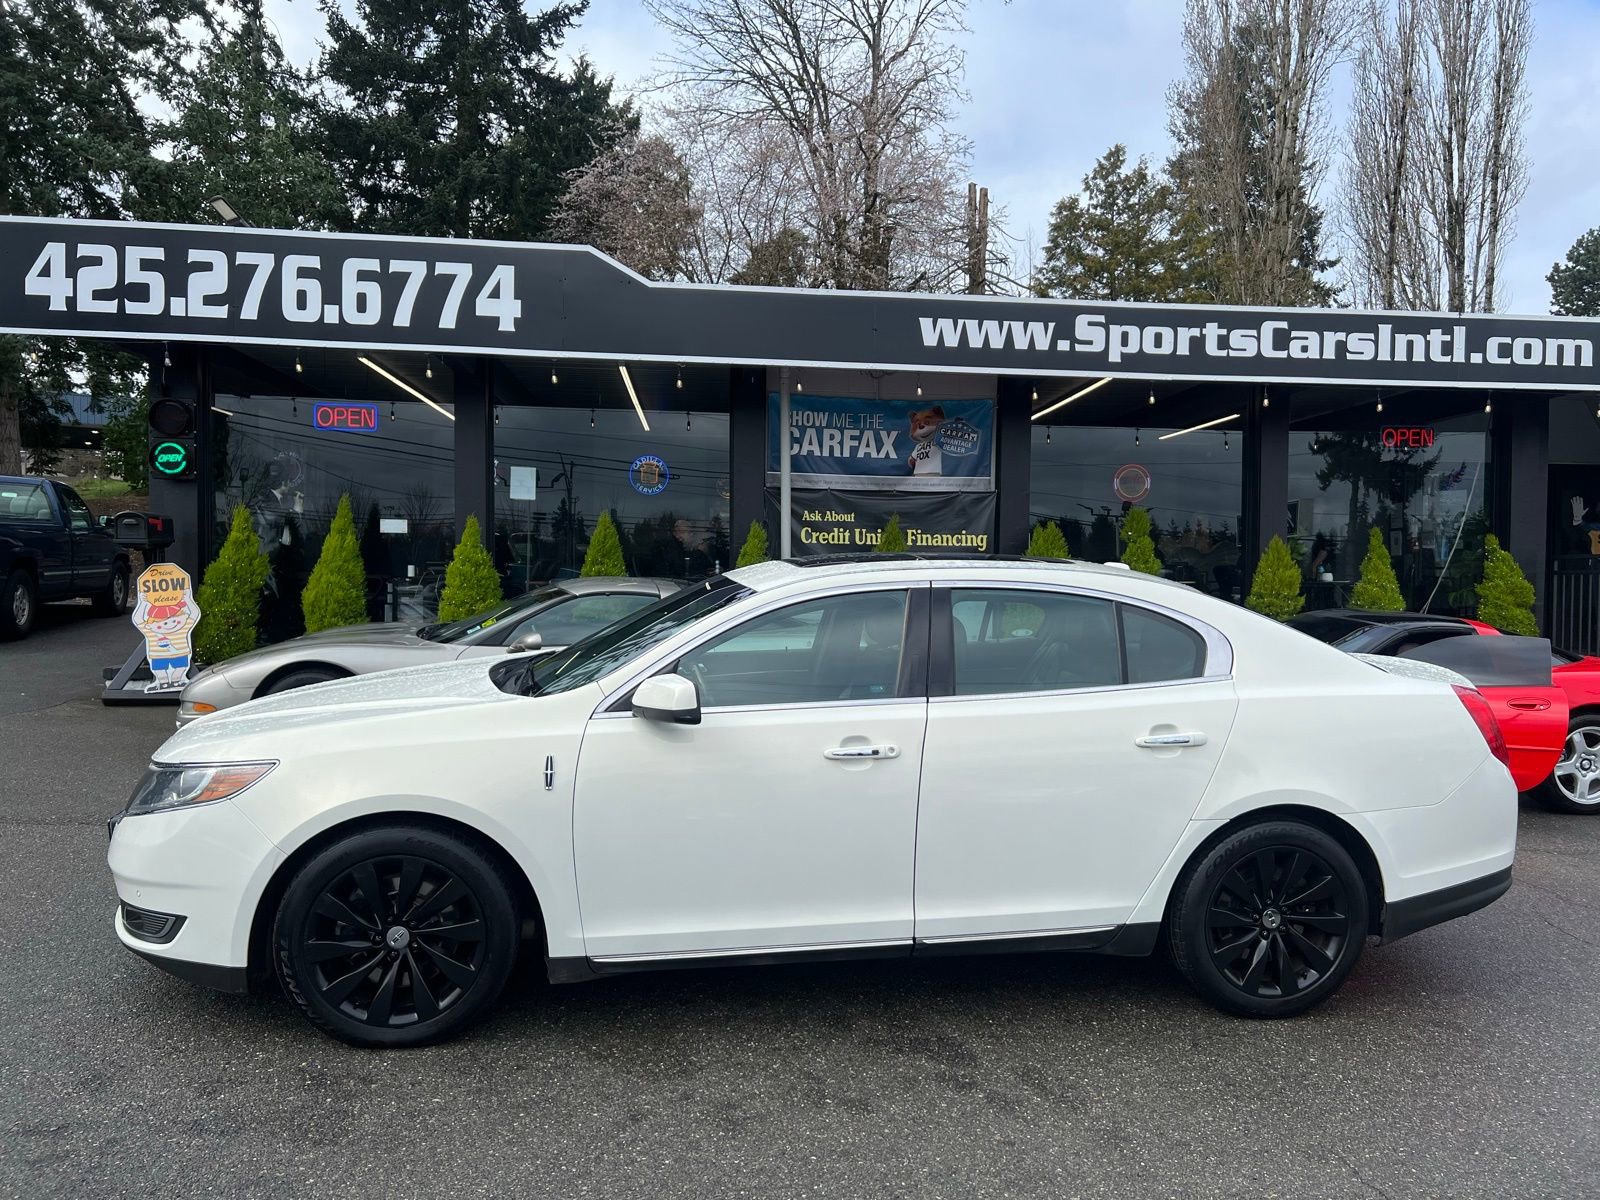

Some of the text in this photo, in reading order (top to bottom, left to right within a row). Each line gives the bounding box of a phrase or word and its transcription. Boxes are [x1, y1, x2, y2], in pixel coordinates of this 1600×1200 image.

[24, 241, 522, 332] 425.276.6774
[919, 313, 1594, 367] www.SportsCarsIntl.com
[316, 406, 376, 428] OPEN
[789, 410, 884, 429] HOW ME THE
[940, 427, 977, 442] CARFAX
[1381, 427, 1434, 448] OPEN
[940, 436, 972, 449] ADVANTAGE
[943, 443, 966, 454] DEALER
[157, 453, 184, 463] OPEN
[916, 450, 931, 461] FOX
[802, 510, 855, 523] Ask About
[800, 527, 988, 551] Credit Uni Financing
[150, 568, 174, 577] Drive
[142, 577, 186, 593] SLOW
[153, 594, 179, 603] please
